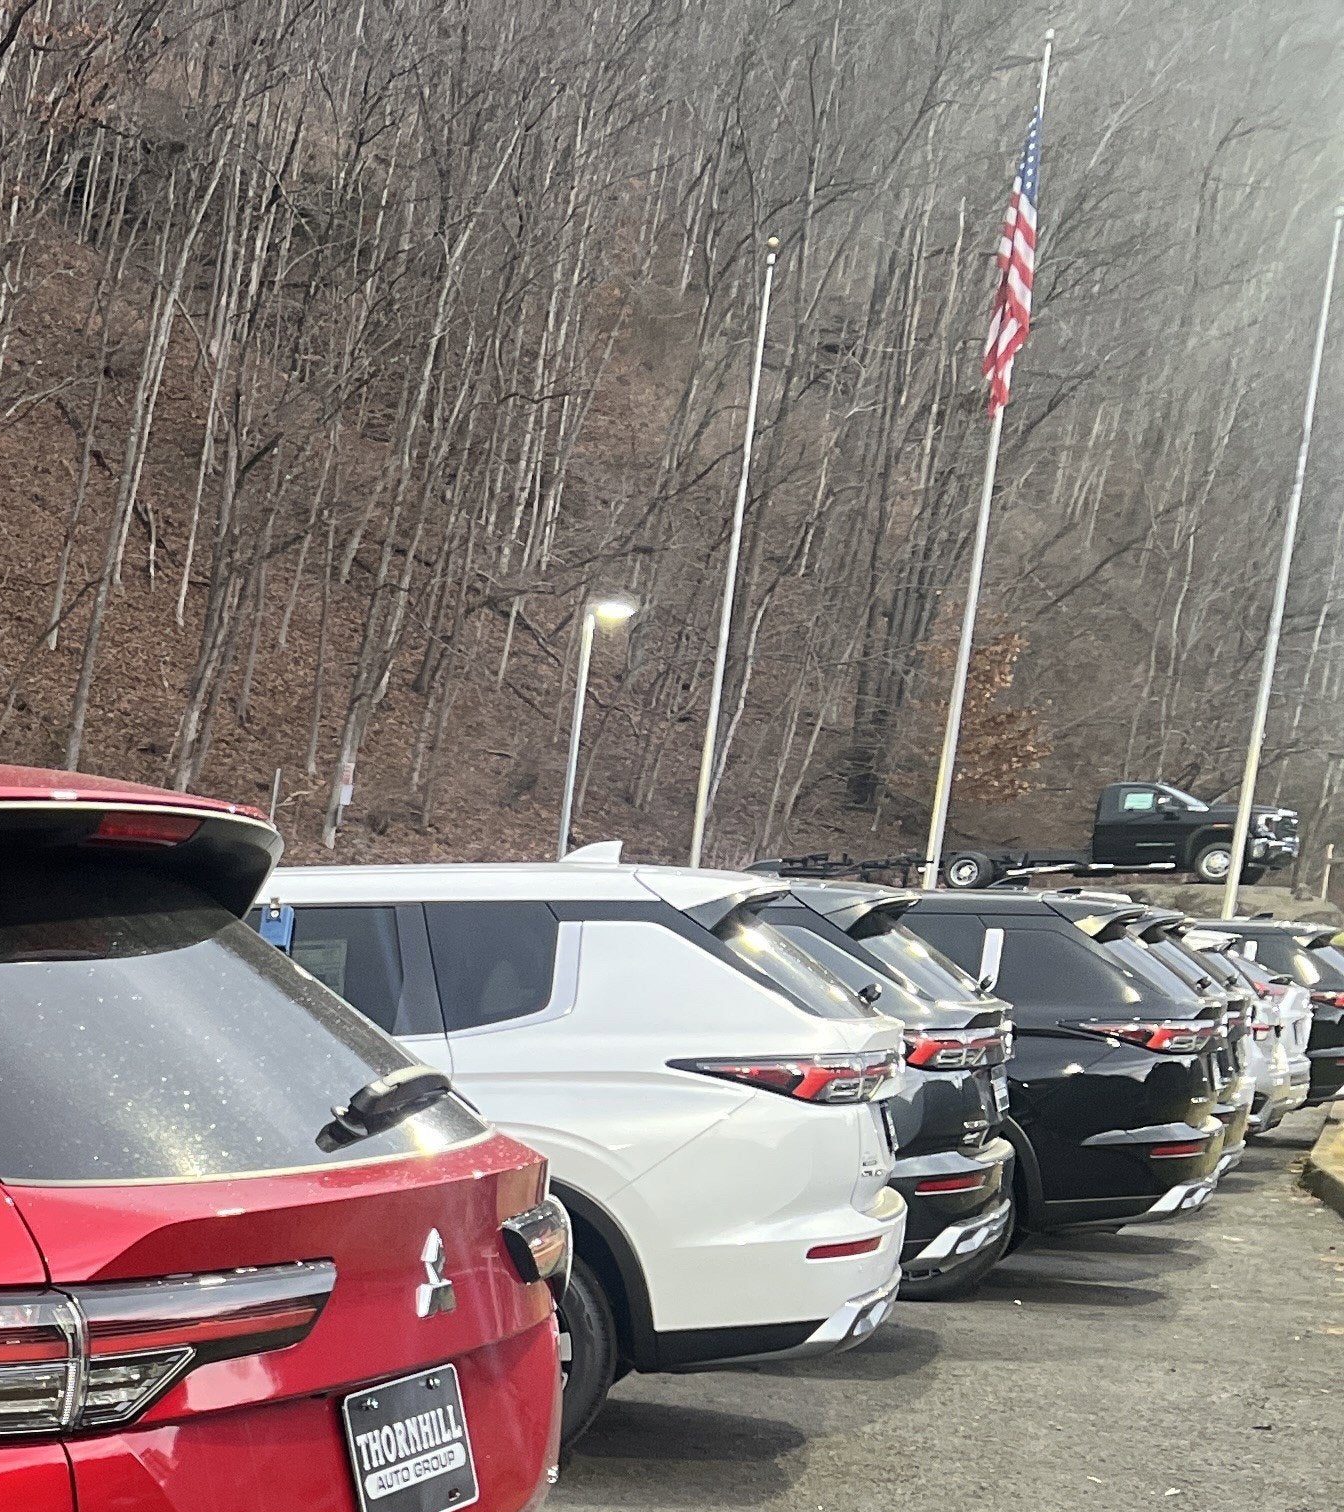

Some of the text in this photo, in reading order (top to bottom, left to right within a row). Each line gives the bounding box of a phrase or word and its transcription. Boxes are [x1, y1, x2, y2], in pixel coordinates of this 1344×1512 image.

[355, 1404, 463, 1471] THORNHILL
[377, 1450, 455, 1491] AUTO GROUP
